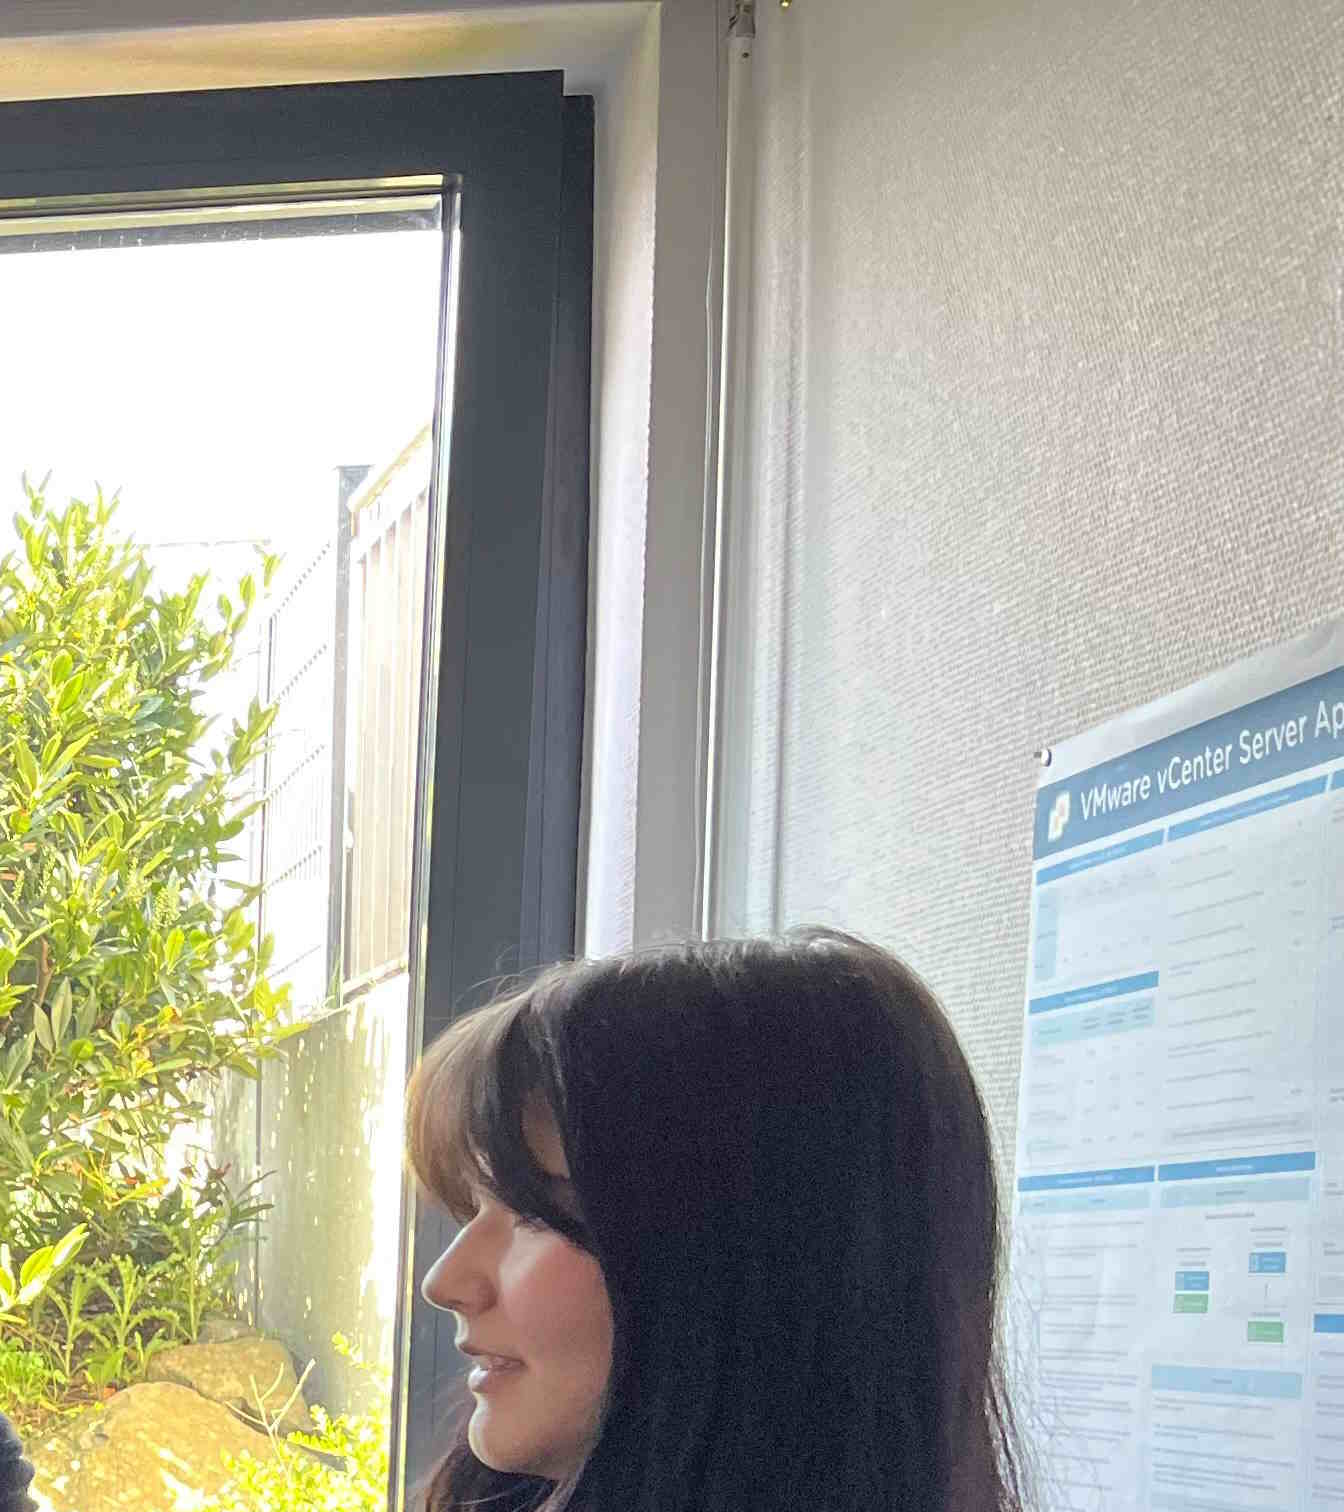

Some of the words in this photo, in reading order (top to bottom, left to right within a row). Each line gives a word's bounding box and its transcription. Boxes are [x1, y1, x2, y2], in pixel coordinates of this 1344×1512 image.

[1080, 774, 1151, 821] VMware
[1157, 743, 1233, 794] vCenter
[1238, 714, 1308, 764] Server
